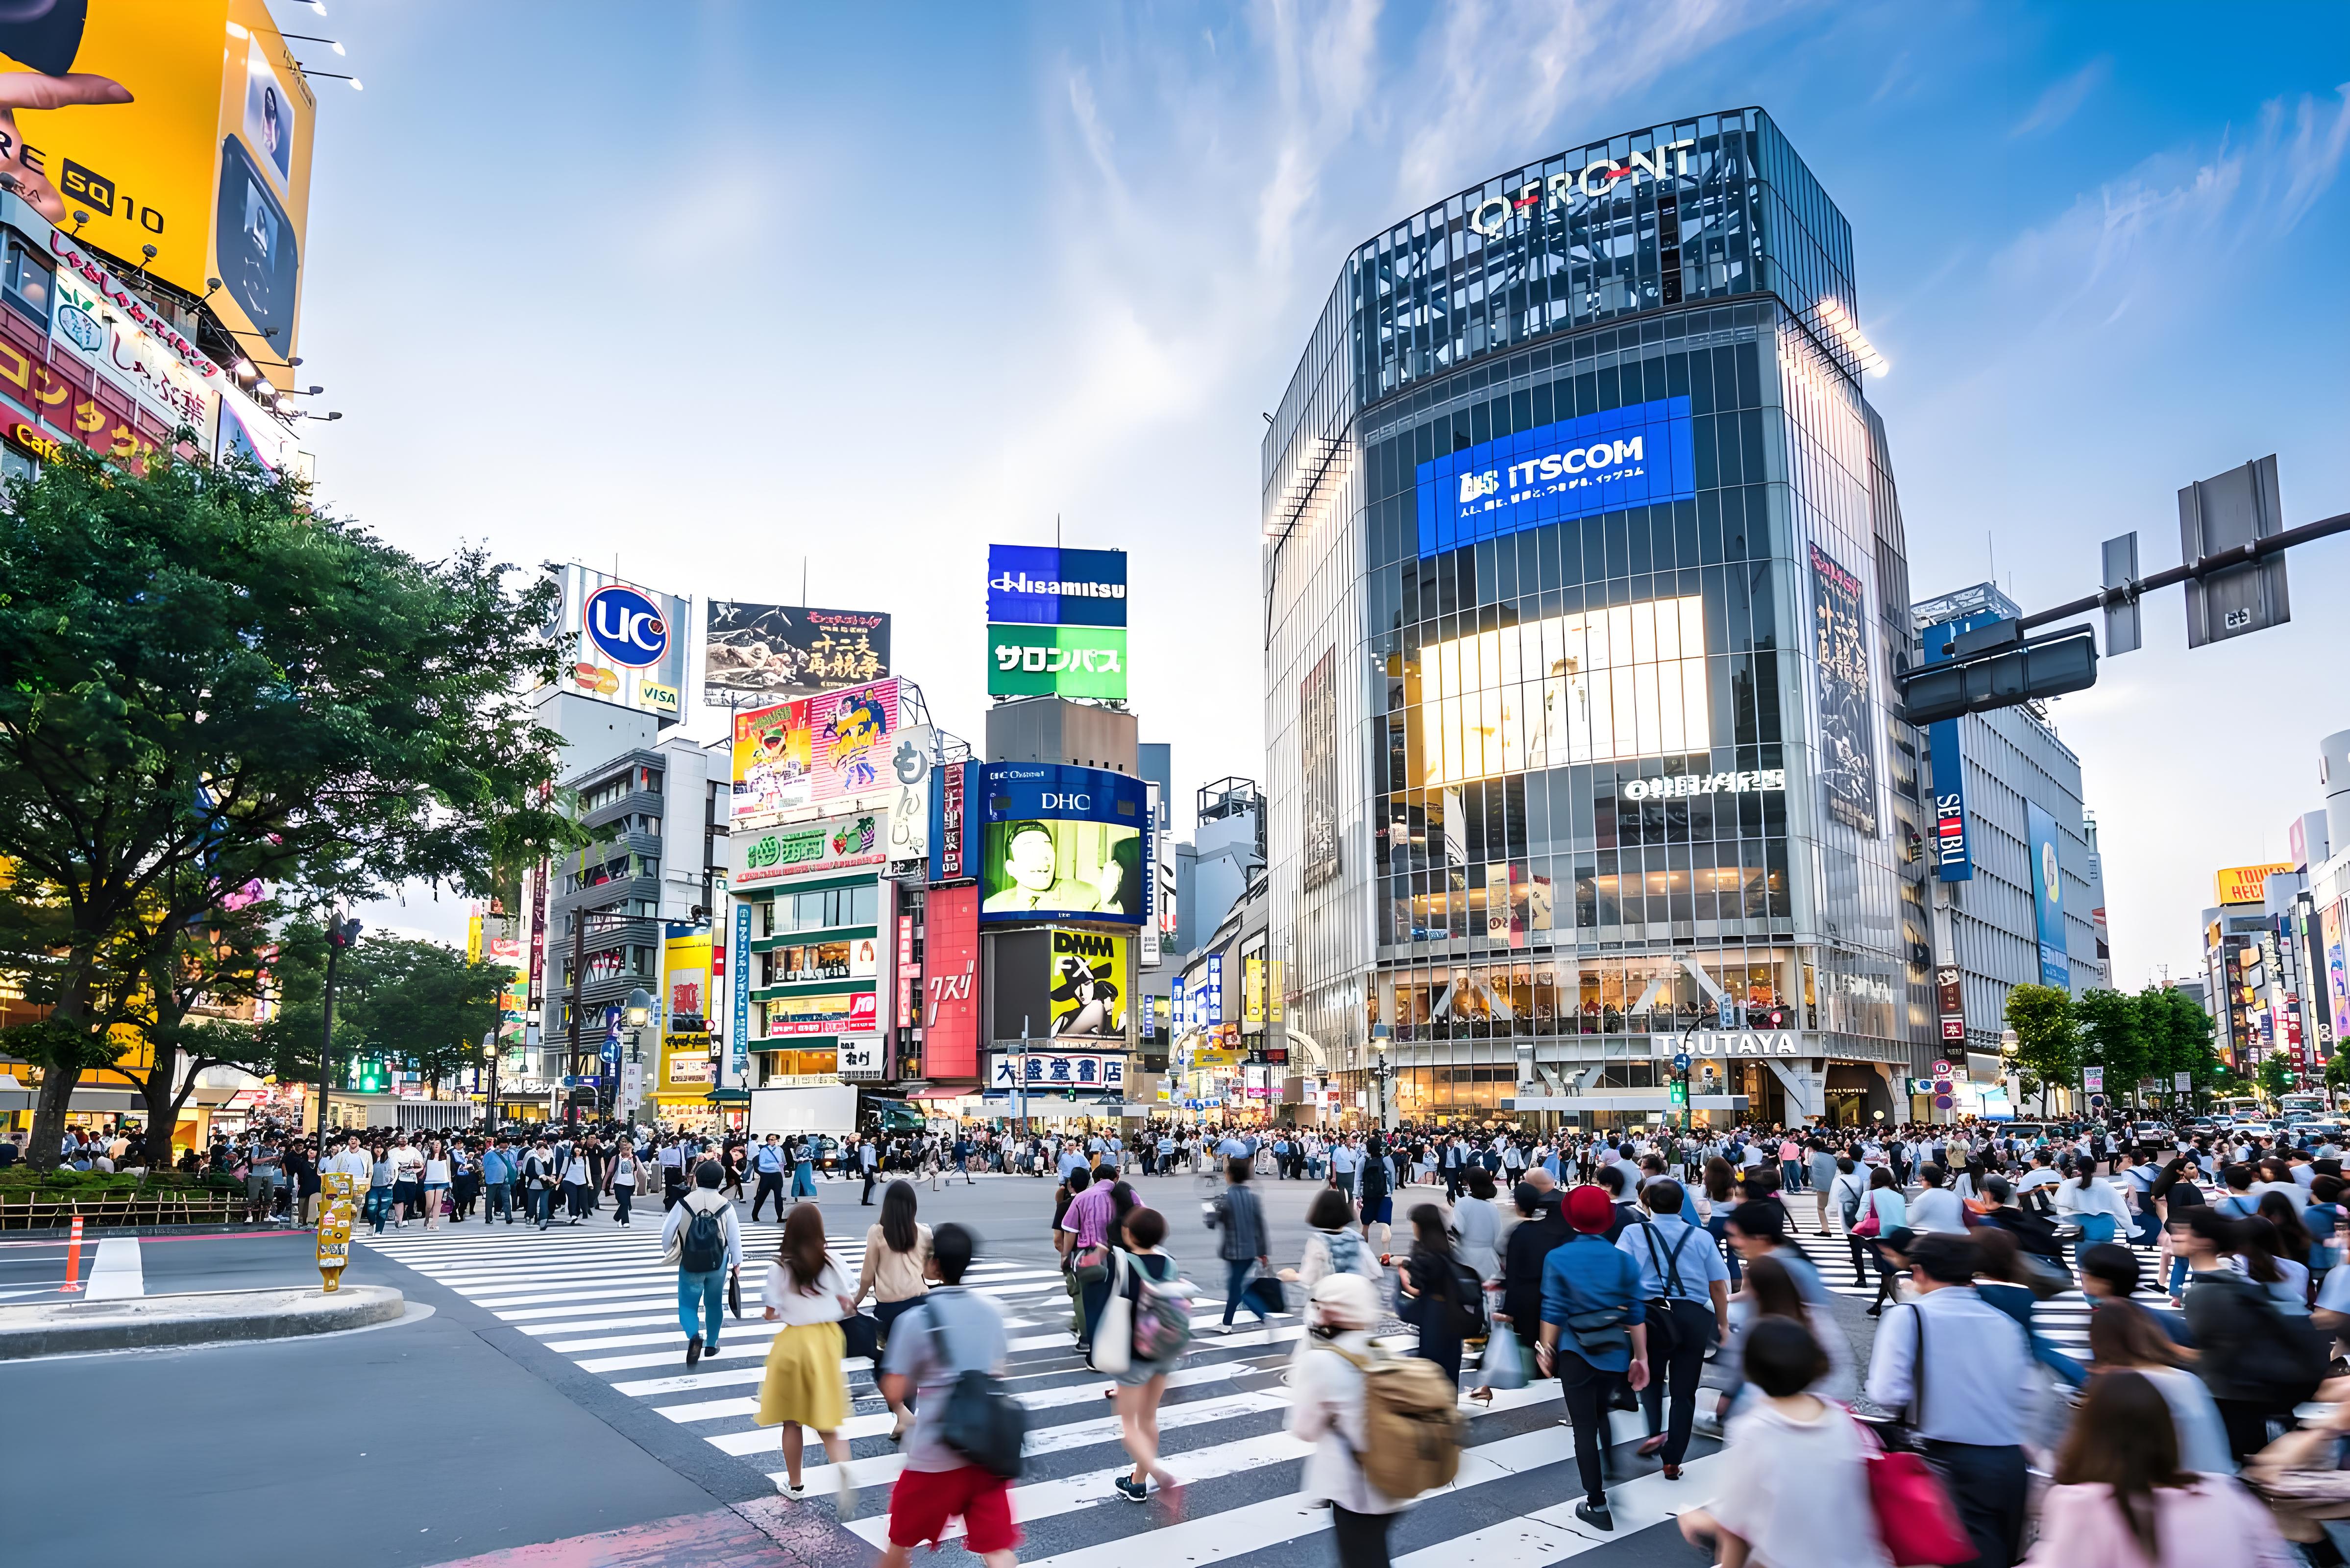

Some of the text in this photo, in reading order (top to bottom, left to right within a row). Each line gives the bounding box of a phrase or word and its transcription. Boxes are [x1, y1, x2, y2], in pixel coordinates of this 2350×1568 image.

[1471, 139, 1694, 236] QFRONT
[990, 571, 1125, 598] Hisamitsu
[995, 644, 1121, 673] サロンパス
[644, 686, 676, 706] VISA
[1042, 792, 1090, 810] DHC
[1937, 793, 1965, 865] SEIBU
[1054, 932, 1114, 957] DMM
[1054, 956, 1094, 979] FX
[1656, 1033, 1797, 1055] TSUTAYA
